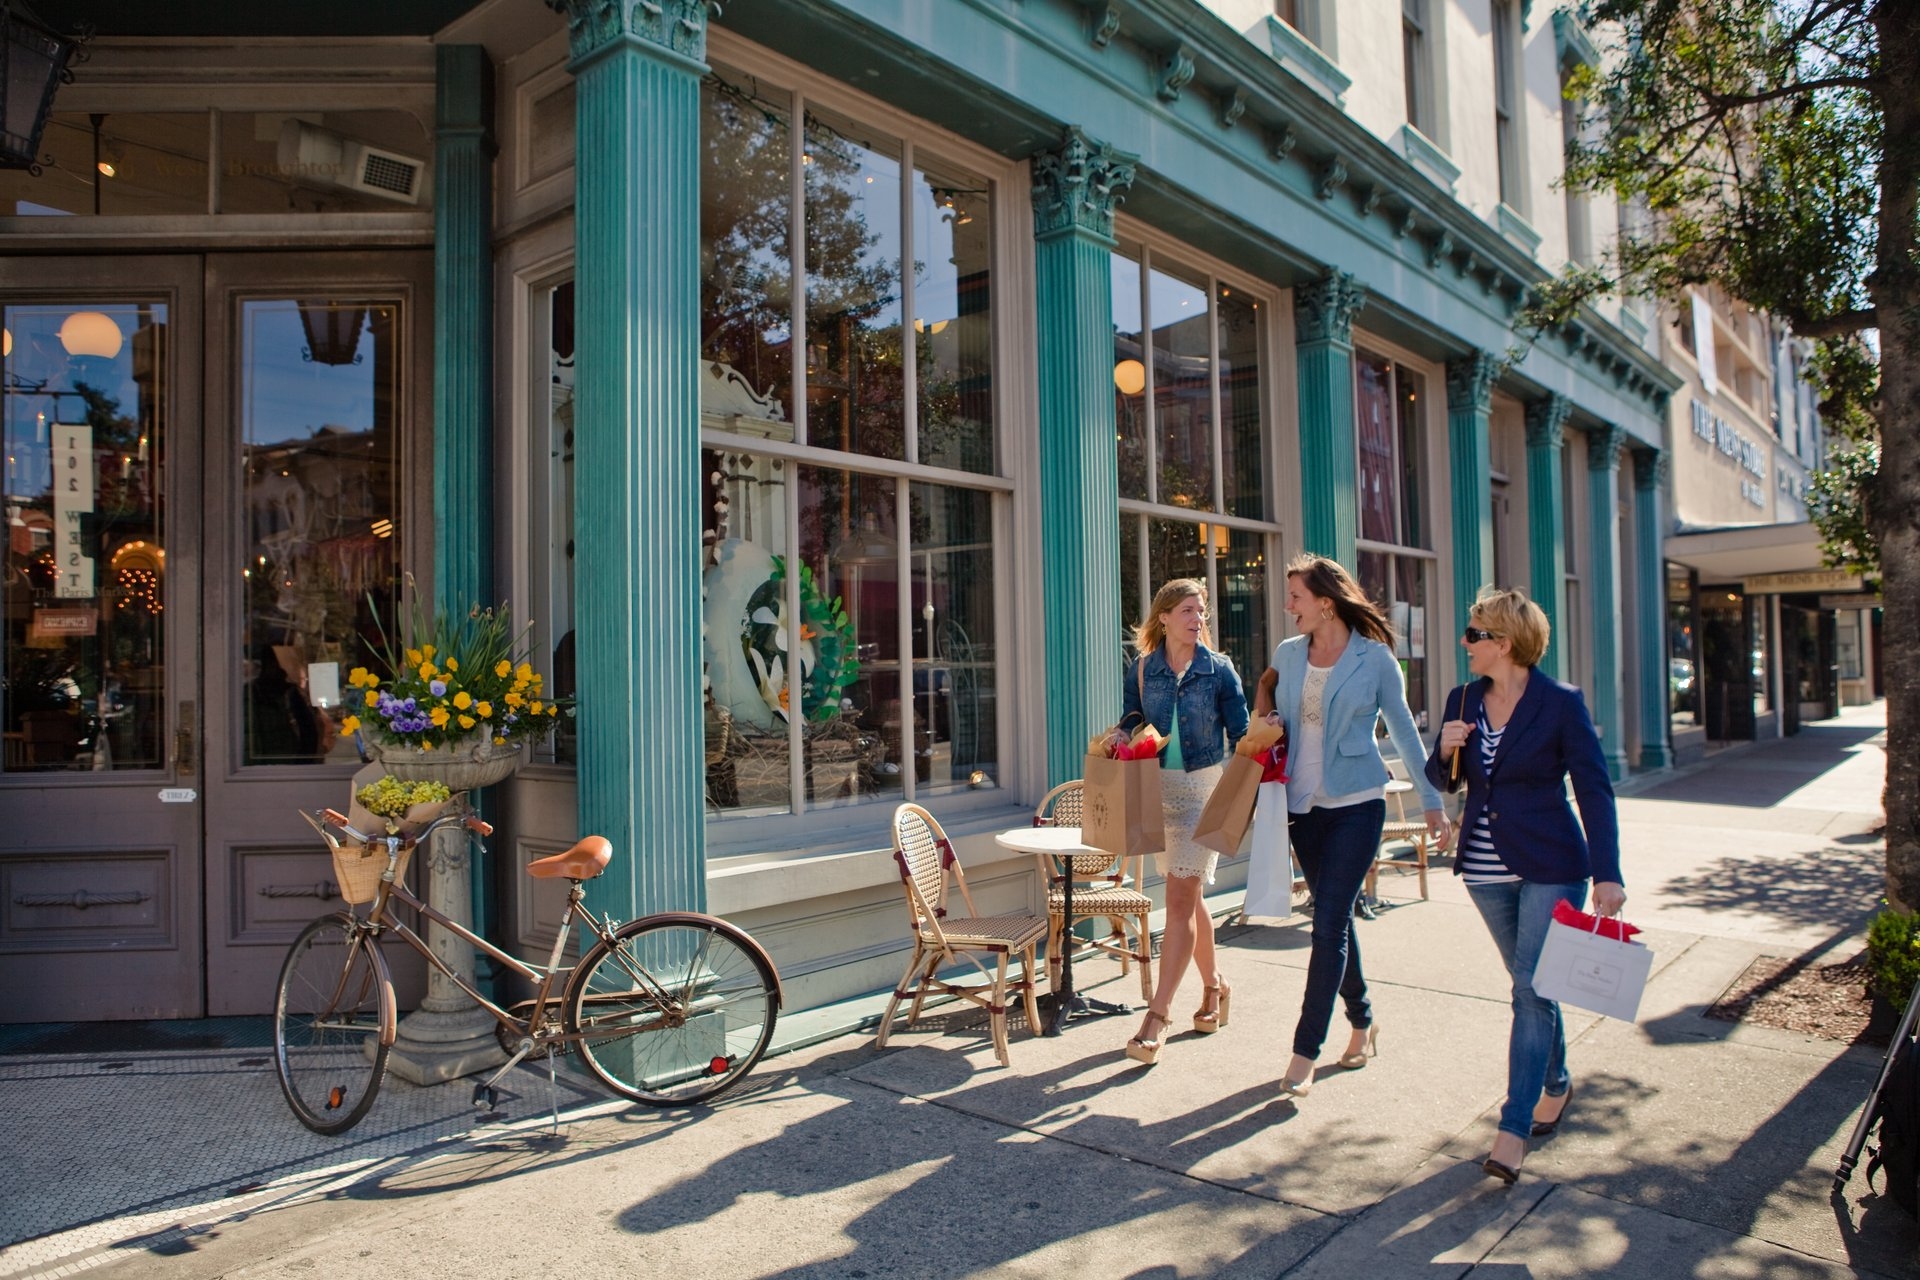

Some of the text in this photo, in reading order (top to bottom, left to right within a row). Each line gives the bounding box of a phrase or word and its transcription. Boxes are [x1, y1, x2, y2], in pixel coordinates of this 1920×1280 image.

[230, 157, 347, 182] Broughton
[1692, 399, 1716, 443] THE
[61, 587, 91, 598] Paris
